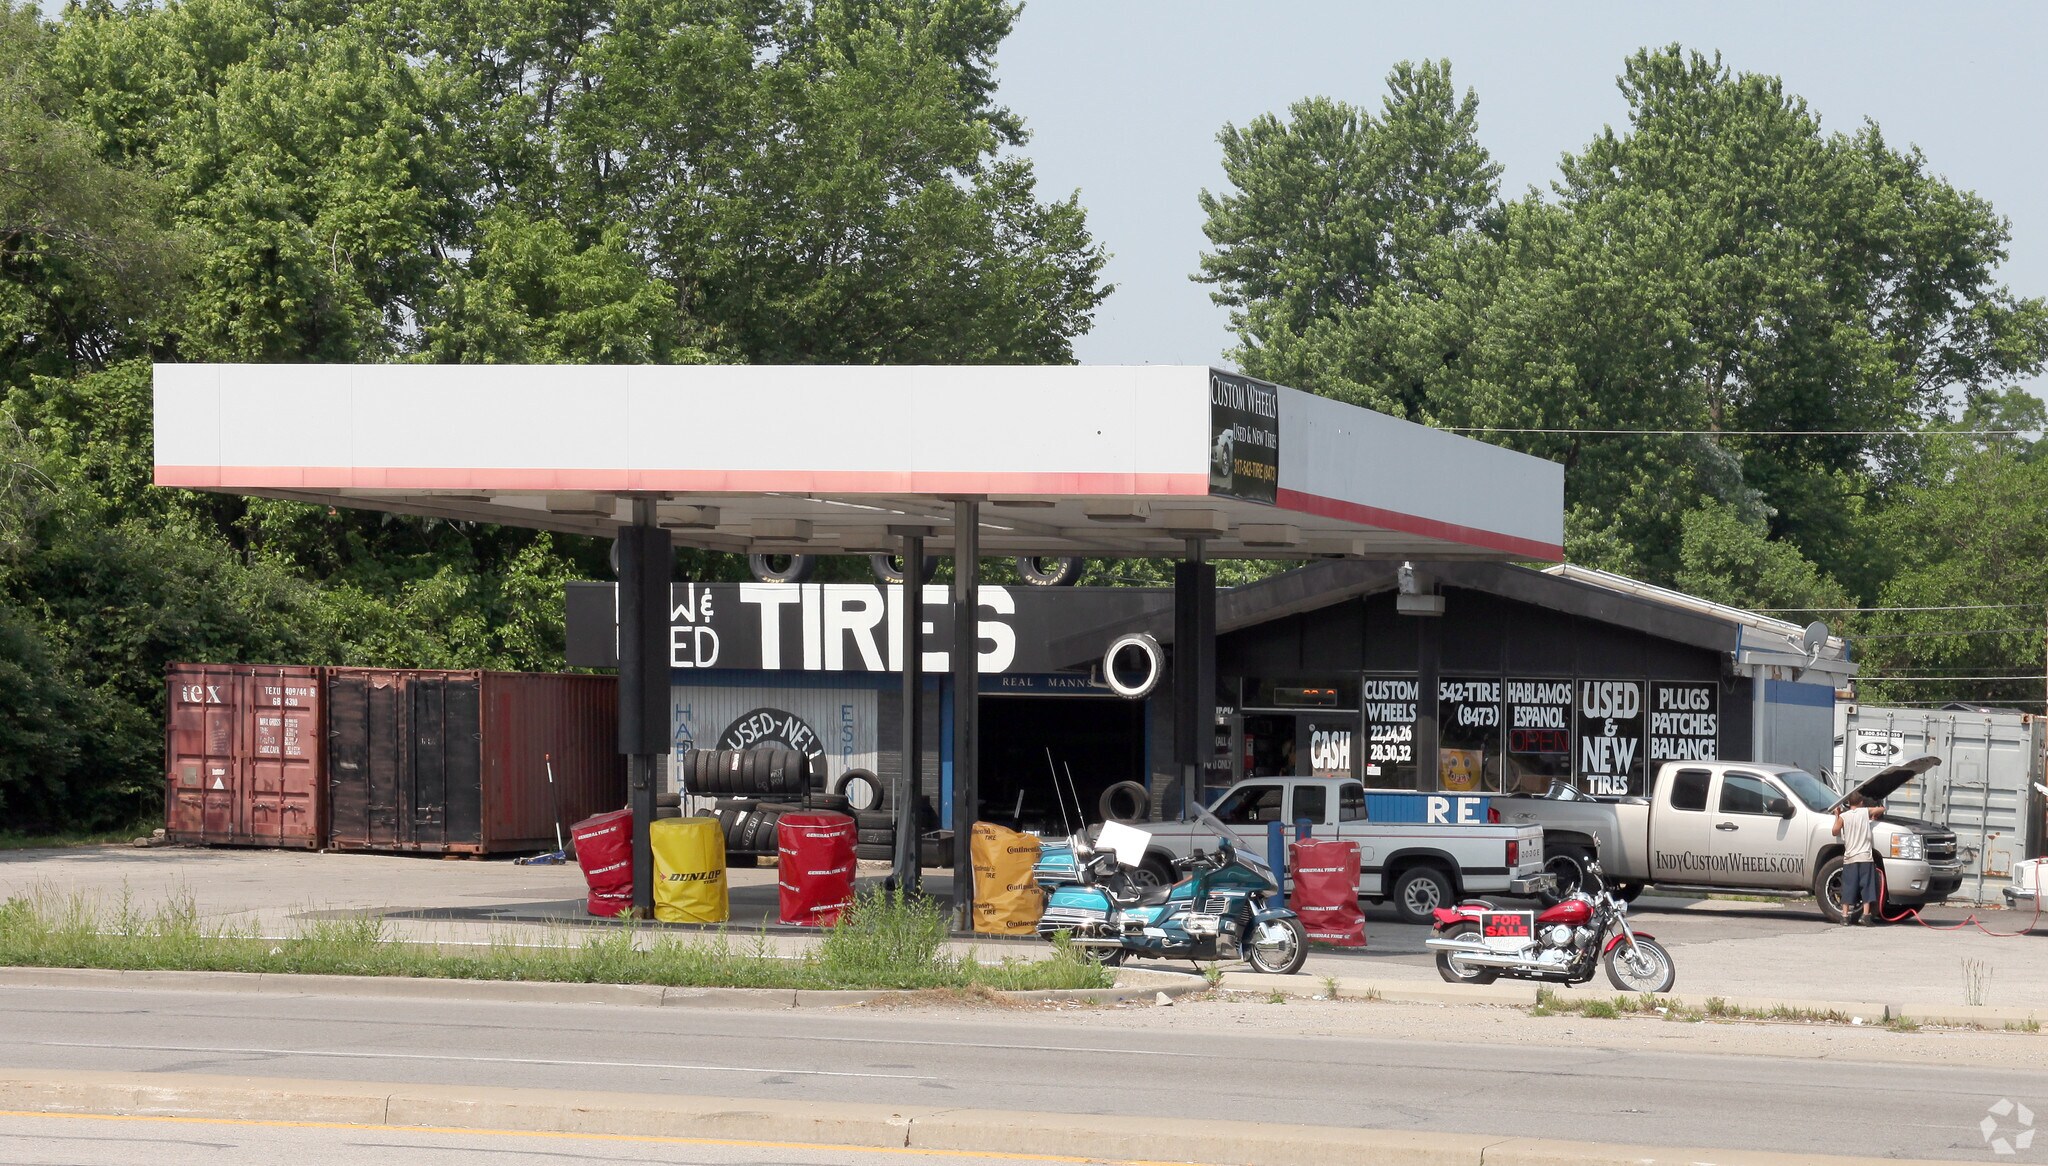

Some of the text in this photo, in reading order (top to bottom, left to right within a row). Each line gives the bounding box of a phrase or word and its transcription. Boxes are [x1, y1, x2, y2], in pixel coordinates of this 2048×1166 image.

[1211, 375, 1276, 418] CUSTOM WHEELS
[1233, 423, 1276, 449] USED & NEW TIRES
[701, 588, 714, 623] &
[740, 583, 1015, 672] TIRES
[265, 686, 280, 695] TEXU
[1002, 678, 1033, 686] REAL
[1365, 681, 1418, 700] CUSTOM
[1439, 682, 1500, 703] 542-TIRE
[1507, 682, 1571, 704] HABLAMOS
[183, 685, 221, 703] tex
[1583, 681, 1640, 719] USED
[1659, 688, 1709, 710] PLUGS
[1366, 703, 1417, 723] WHEELS
[1458, 704, 1500, 726] (8473)
[1514, 706, 1565, 728] ESPANOL
[1651, 712, 1716, 736] PATCHES
[1370, 725, 1412, 744] 22,24,26
[1604, 718, 1618, 737] &
[1311, 730, 1350, 770] CASH
[1510, 730, 1569, 752] OPEN
[1651, 737, 1716, 760] BALANCE
[1370, 744, 1411, 763] 28,30,32
[1582, 736, 1638, 774] NEW
[1587, 775, 1628, 795] TIRES
[1428, 796, 1480, 824] RE
[1522, 849, 1540, 858] DODGE
[1656, 851, 1804, 876] INDYCUSTOMWHEELS.COM
[668, 869, 721, 881] DUNLOP
[1486, 926, 1528, 936] SALE
[1492, 915, 1521, 925] FOR
